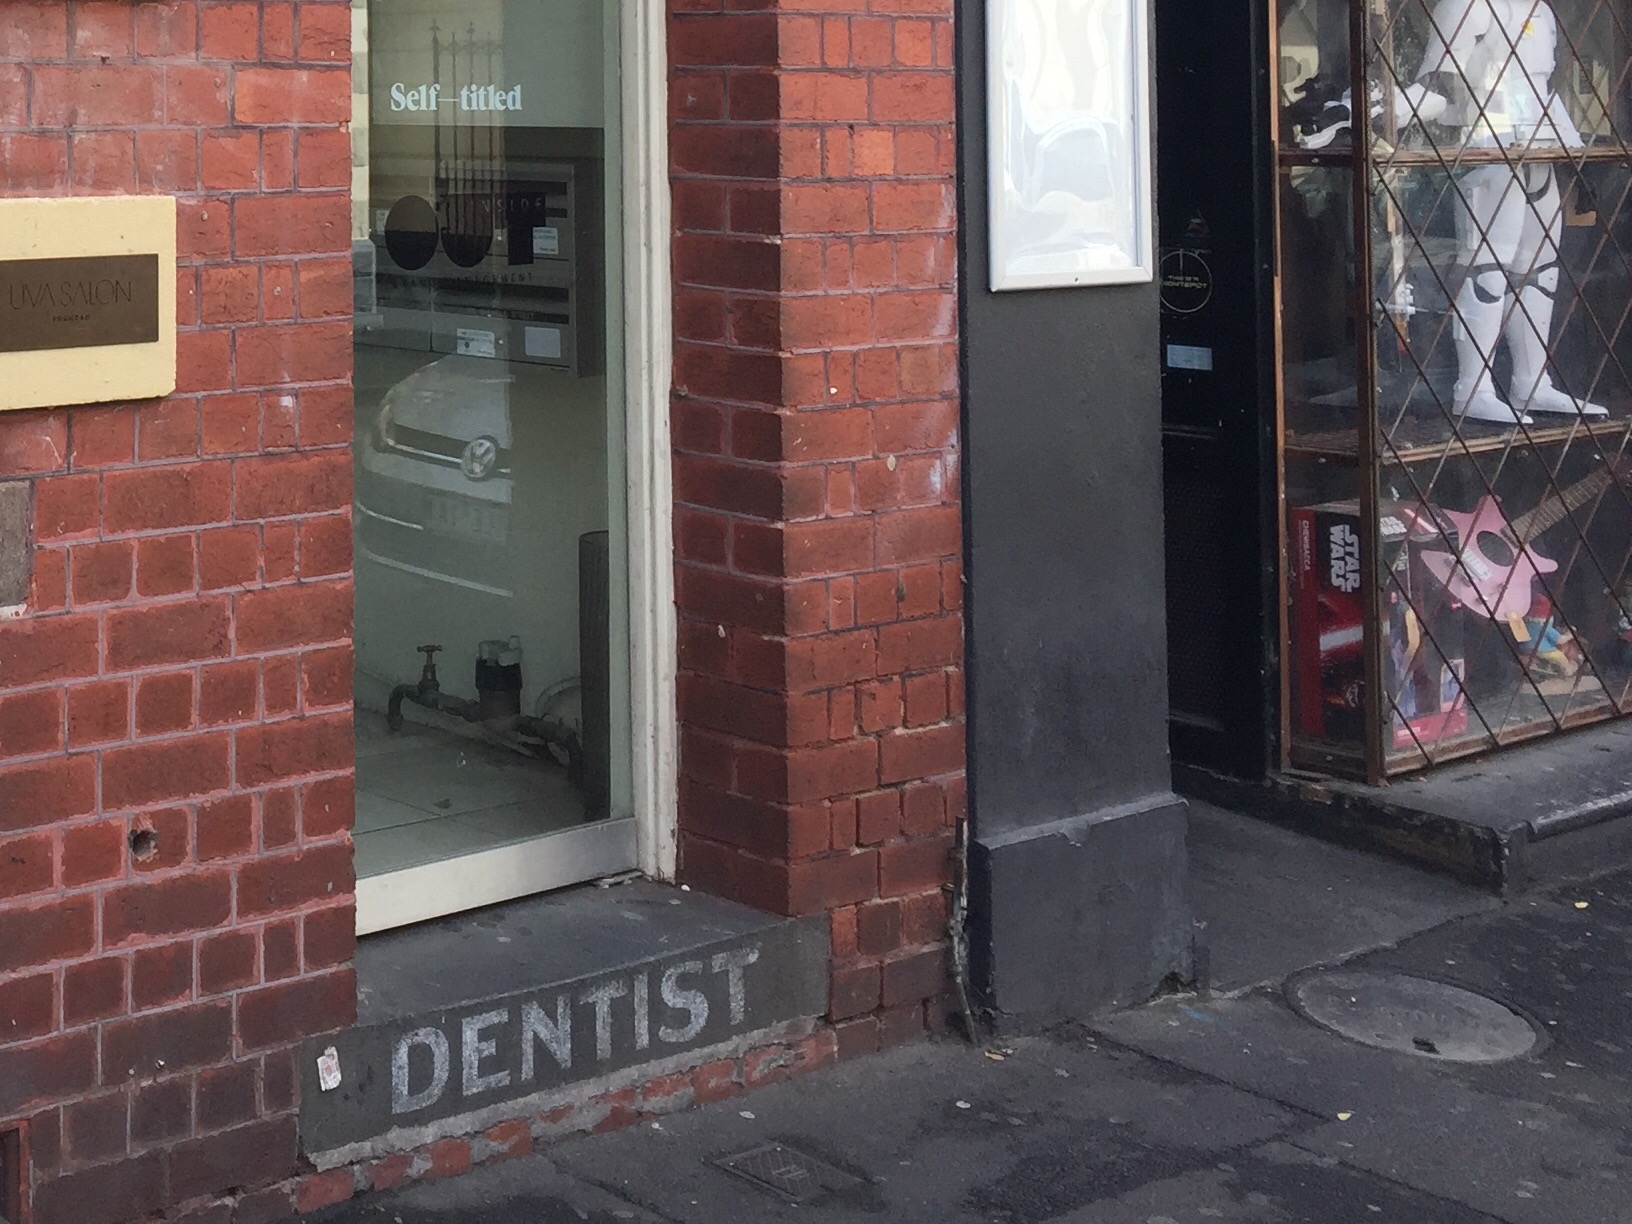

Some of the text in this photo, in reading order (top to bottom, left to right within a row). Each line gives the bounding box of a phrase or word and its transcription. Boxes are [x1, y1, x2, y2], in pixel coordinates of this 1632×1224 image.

[8, 278, 132, 309] UVA SALON
[1329, 525, 1346, 593] WARS
[1344, 524, 1361, 593] STAR
[390, 946, 760, 1116] DENTIST
